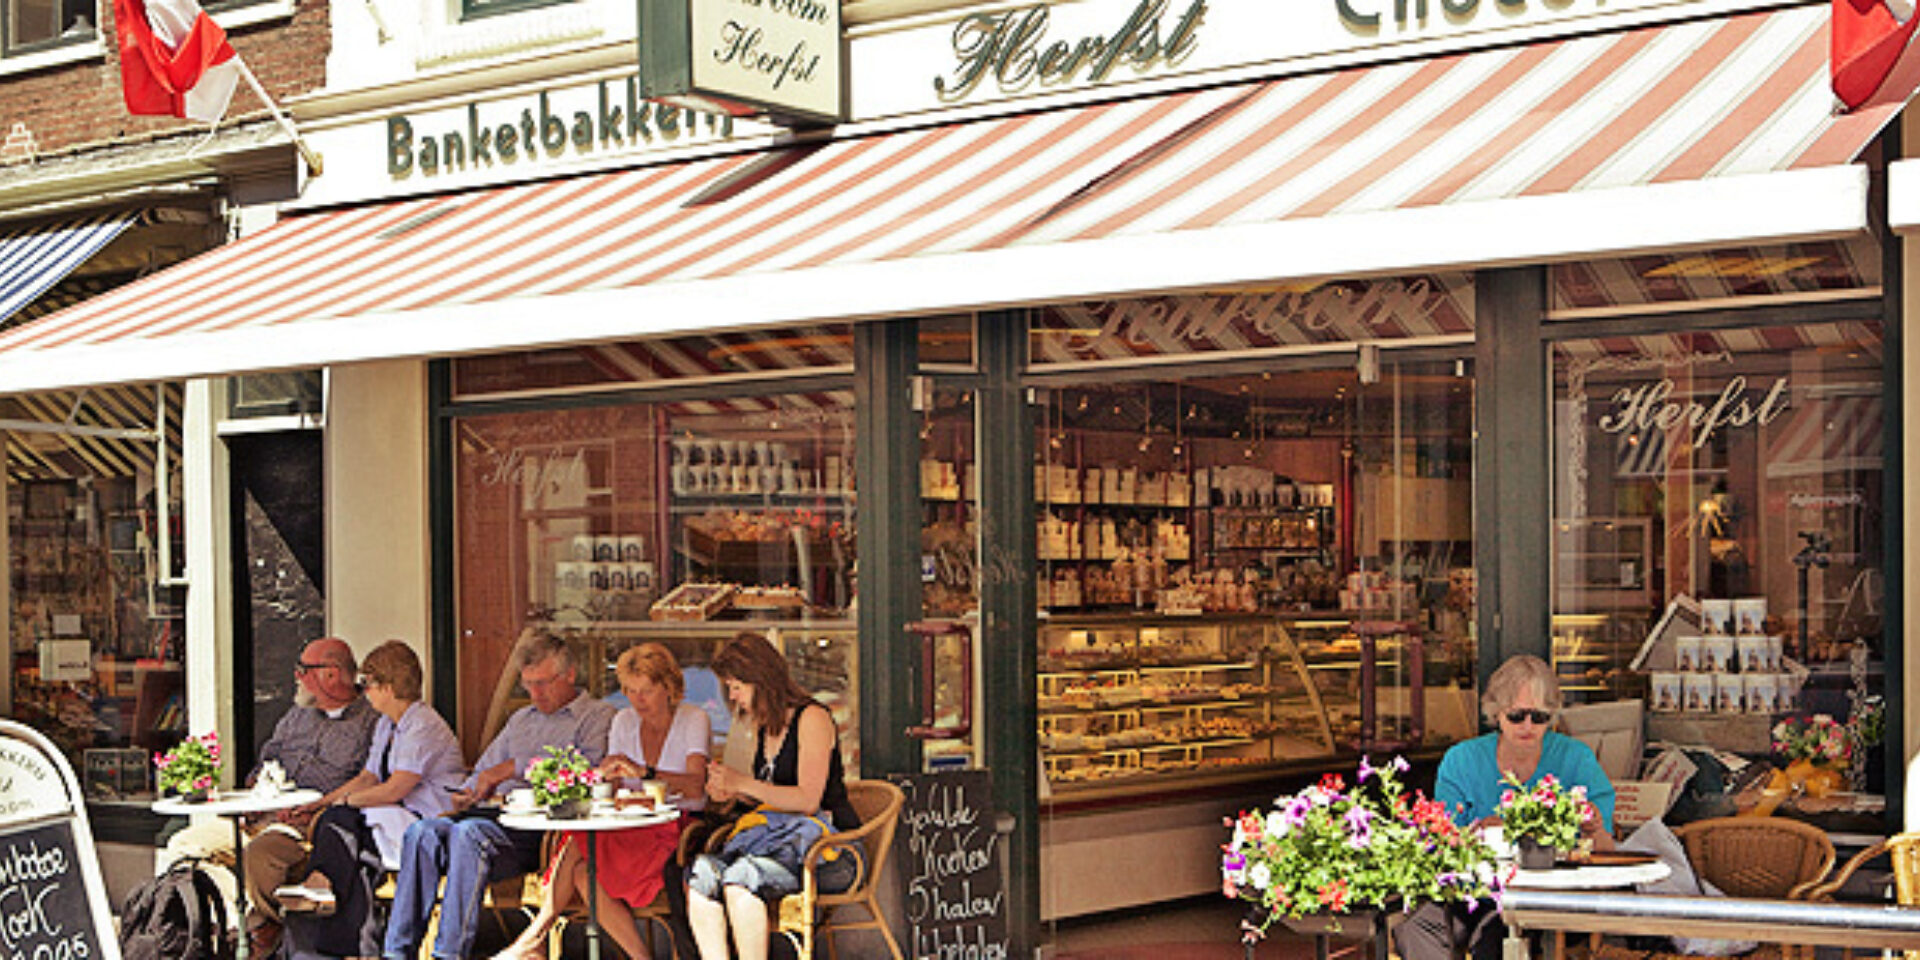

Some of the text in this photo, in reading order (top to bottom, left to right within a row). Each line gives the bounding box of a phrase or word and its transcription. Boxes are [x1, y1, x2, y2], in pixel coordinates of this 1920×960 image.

[713, 20, 821, 90] Herfst
[933, 0, 1206, 96] Herfst
[387, 74, 734, 178] Banketbakke
[1599, 375, 1790, 449] Herfst
[932, 878, 1004, 921] halen
